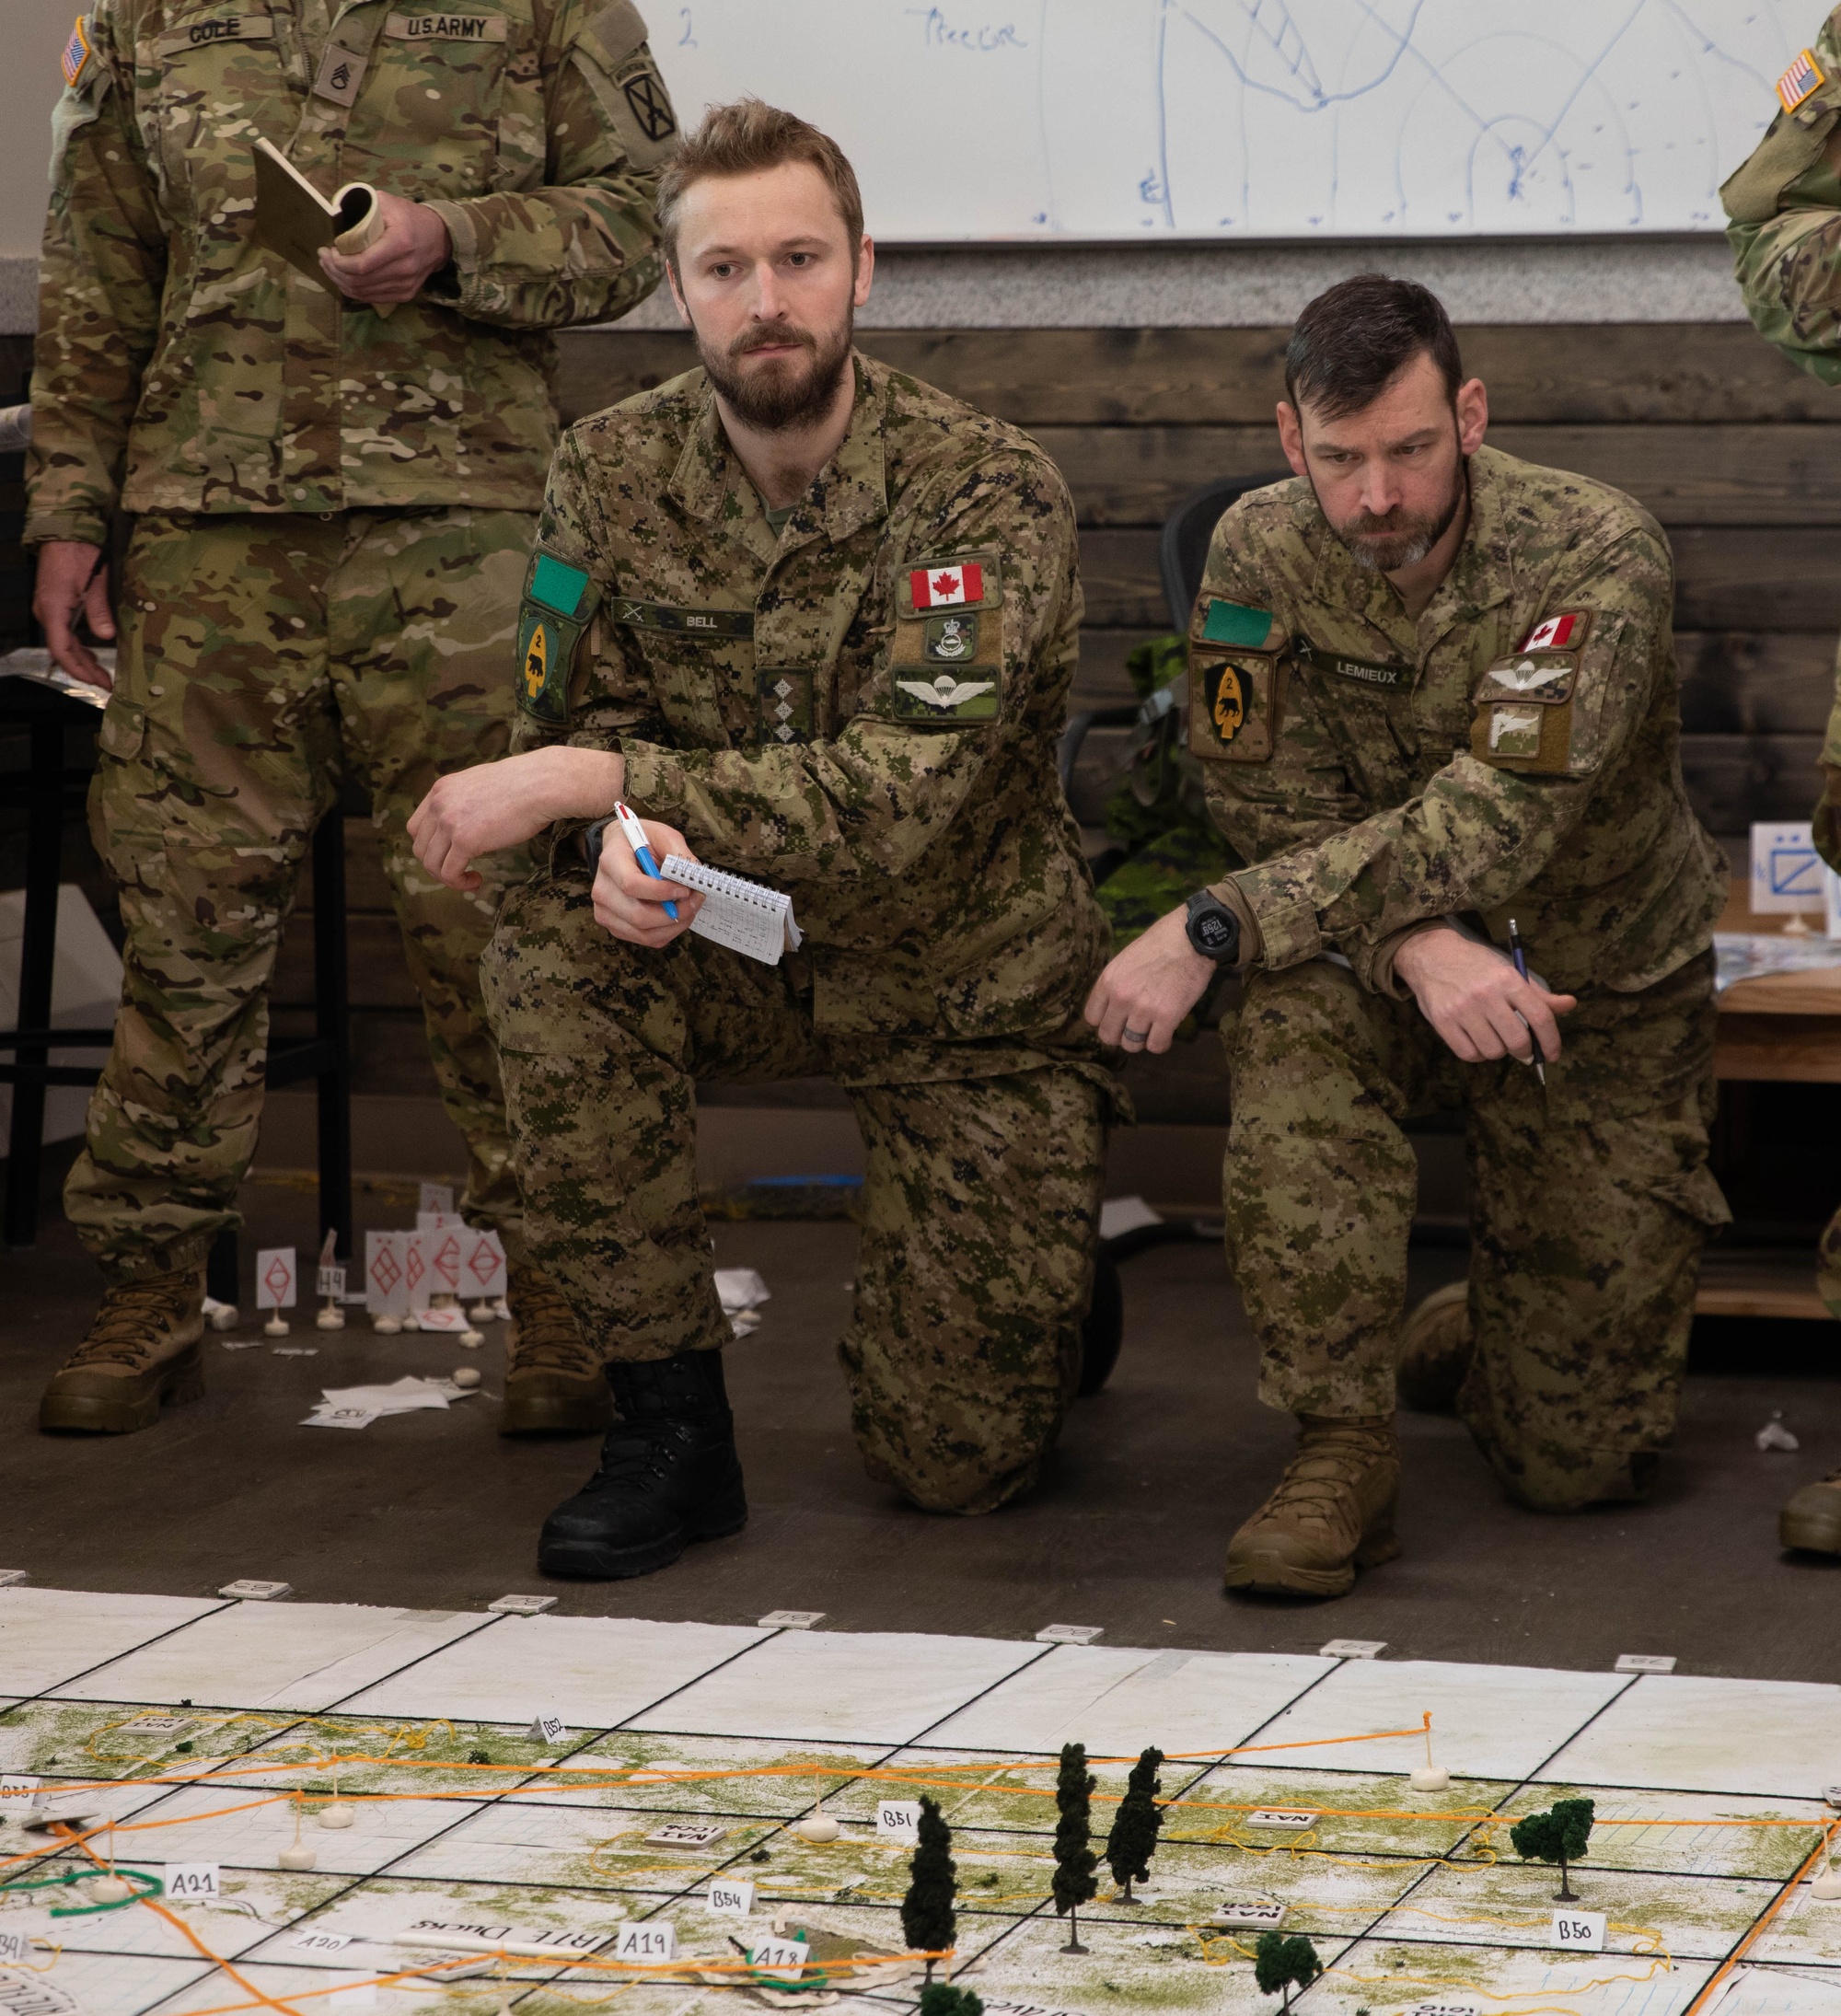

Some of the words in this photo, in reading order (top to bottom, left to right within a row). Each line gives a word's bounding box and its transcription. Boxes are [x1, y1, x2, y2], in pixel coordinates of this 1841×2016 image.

[190, 18, 241, 43] COLE
[677, 7, 698, 48] 2
[687, 616, 718, 628] BELL
[536, 634, 542, 648] 2
[1337, 661, 1397, 684] LEMIEUX
[1226, 678, 1233, 689] 2
[543, 1717, 563, 1738] B52
[883, 1810, 911, 1827] B51
[1256, 1813, 1310, 1822] NAI
[656, 1830, 709, 1841] NAI
[171, 1873, 216, 1894] A21
[713, 1890, 742, 1909] B54
[1220, 1909, 1279, 1918] NAI
[1558, 1919, 1592, 1941] B50
[297, 1936, 340, 1950] A20
[623, 1932, 666, 1953] A19
[755, 1947, 798, 1972] A18
